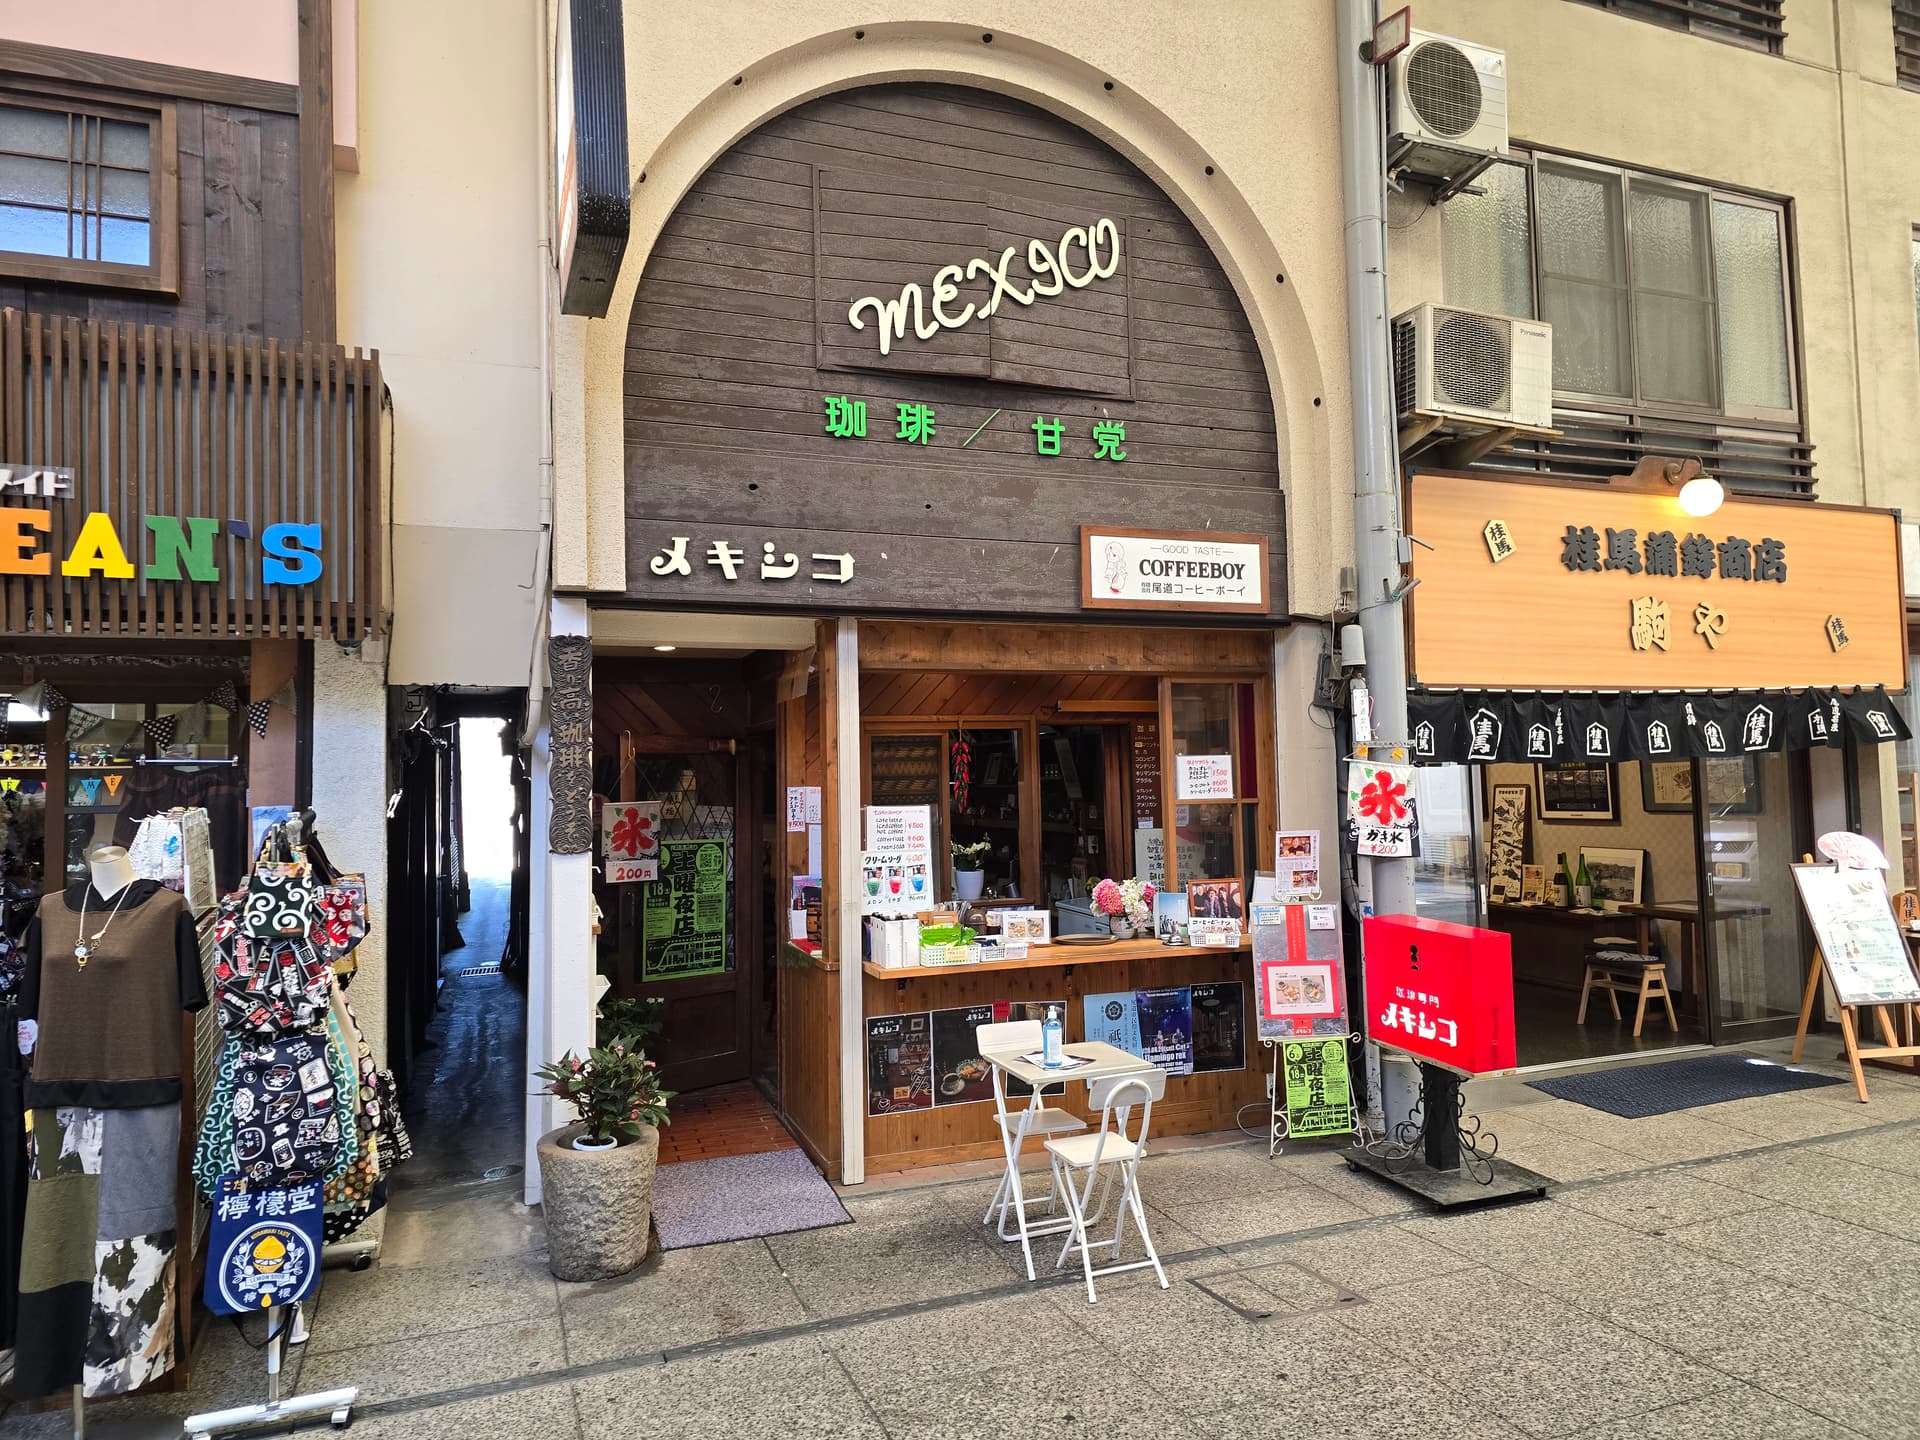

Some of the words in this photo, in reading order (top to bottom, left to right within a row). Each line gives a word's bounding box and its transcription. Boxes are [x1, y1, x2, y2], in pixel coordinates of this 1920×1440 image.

[848, 218, 1120, 357] MEXICO
[1162, 545, 1189, 554] GOOD
[1193, 546, 1222, 556] TASTE
[1488, 522, 1512, 557] 桂馬
[649, 536, 856, 584] メキシコ
[1560, 526, 1788, 583] 桂馬蒲鉾商店
[1138, 559, 1246, 580] COFFEEBOY
[1831, 615, 1850, 648] 桂馬
[1418, 727, 1430, 751] 桂馬
[1531, 729, 1546, 752] 桂馬
[1590, 728, 1603, 750] 桂馬
[1650, 726, 1666, 748] 桂馬
[1707, 726, 1721, 748] 桂馬
[1749, 713, 1767, 745] 桂馬
[1359, 770, 1407, 826] 氷
[610, 807, 655, 857] 氷
[1370, 844, 1399, 855] ¥200
[651, 882, 663, 896] 18
[670, 850, 697, 937] 土曜夜店
[870, 1025, 900, 1035] メキシコ
[1380, 1002, 1458, 1048] メキシコ
[1289, 1049, 1295, 1059] 6
[1290, 1069, 1299, 1080] 18
[1305, 1046, 1326, 1106] 土曜夜店
[217, 1184, 318, 1222] 檸檬堂
